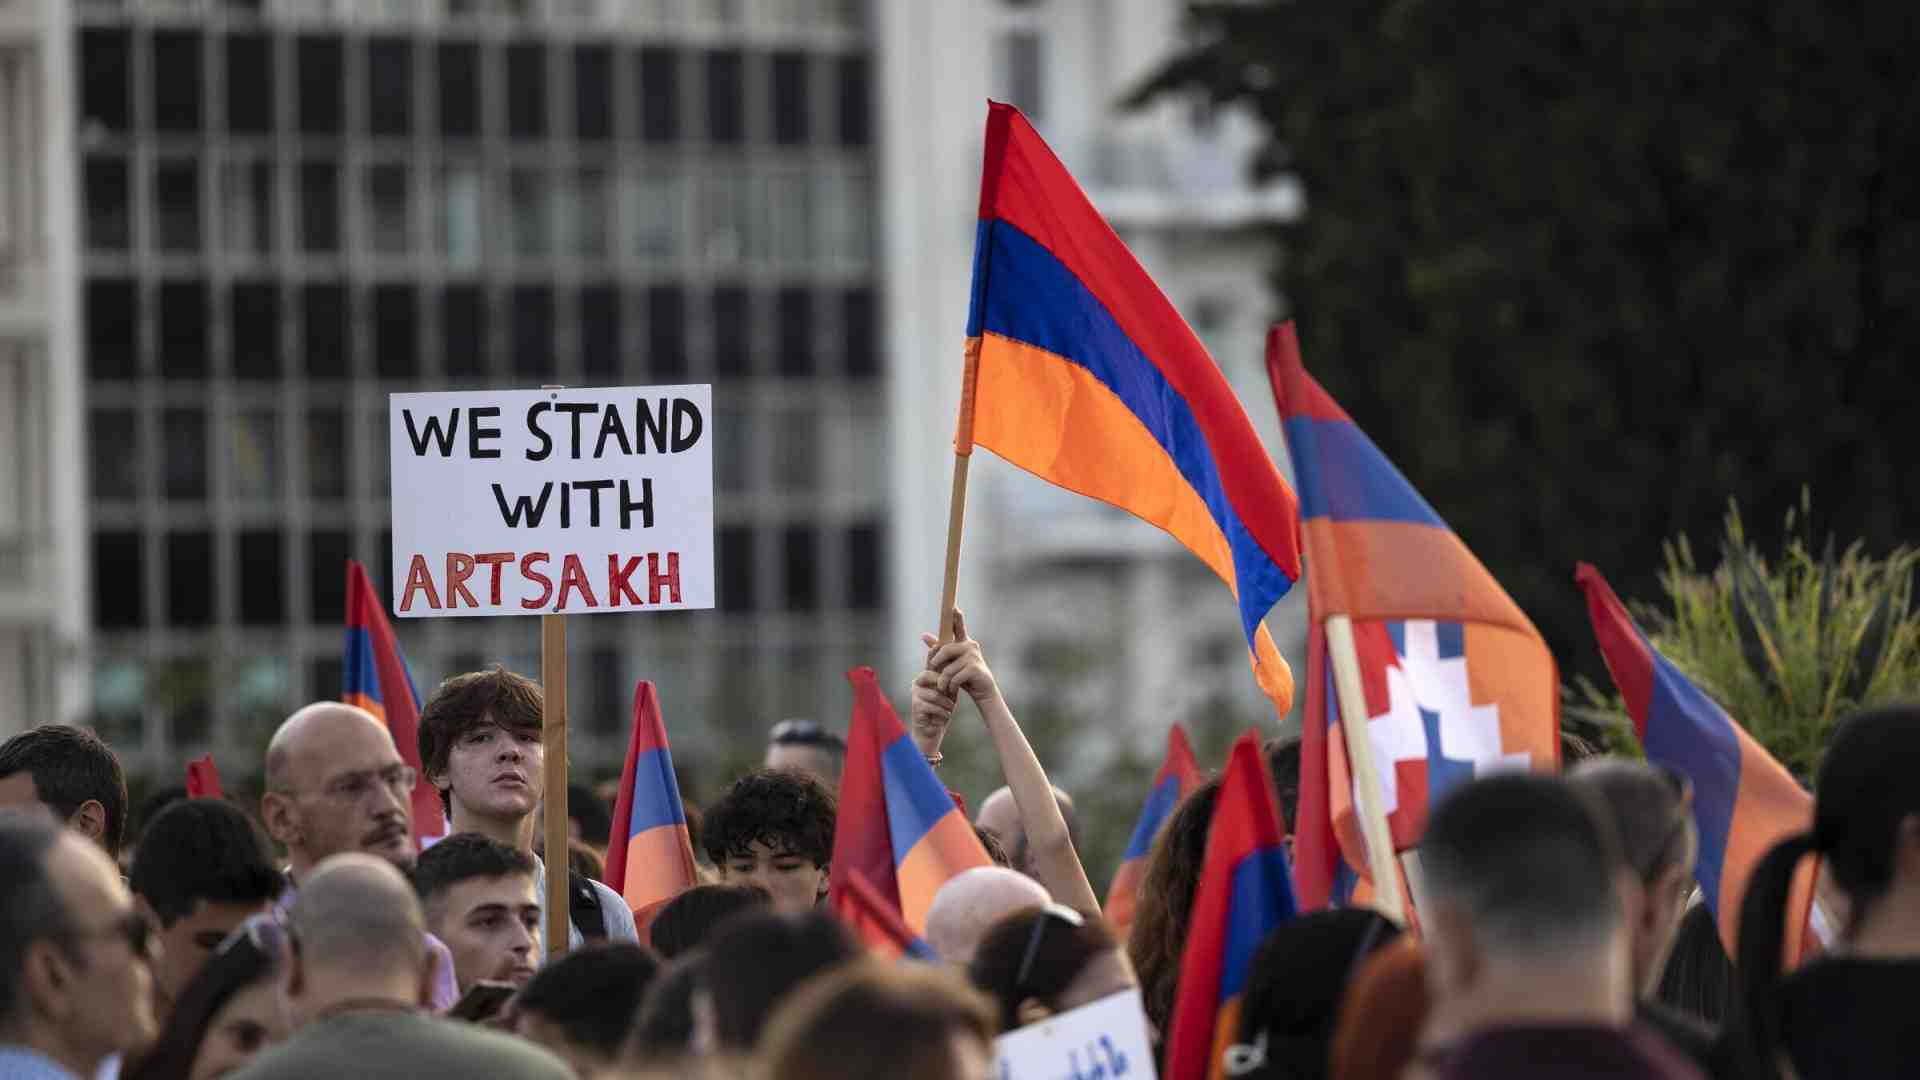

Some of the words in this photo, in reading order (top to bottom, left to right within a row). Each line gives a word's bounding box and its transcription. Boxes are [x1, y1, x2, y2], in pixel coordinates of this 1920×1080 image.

[402, 407, 500, 459] WE
[526, 398, 703, 461] STAND
[491, 478, 654, 529] WITH
[400, 552, 682, 611] ARTSAKH
